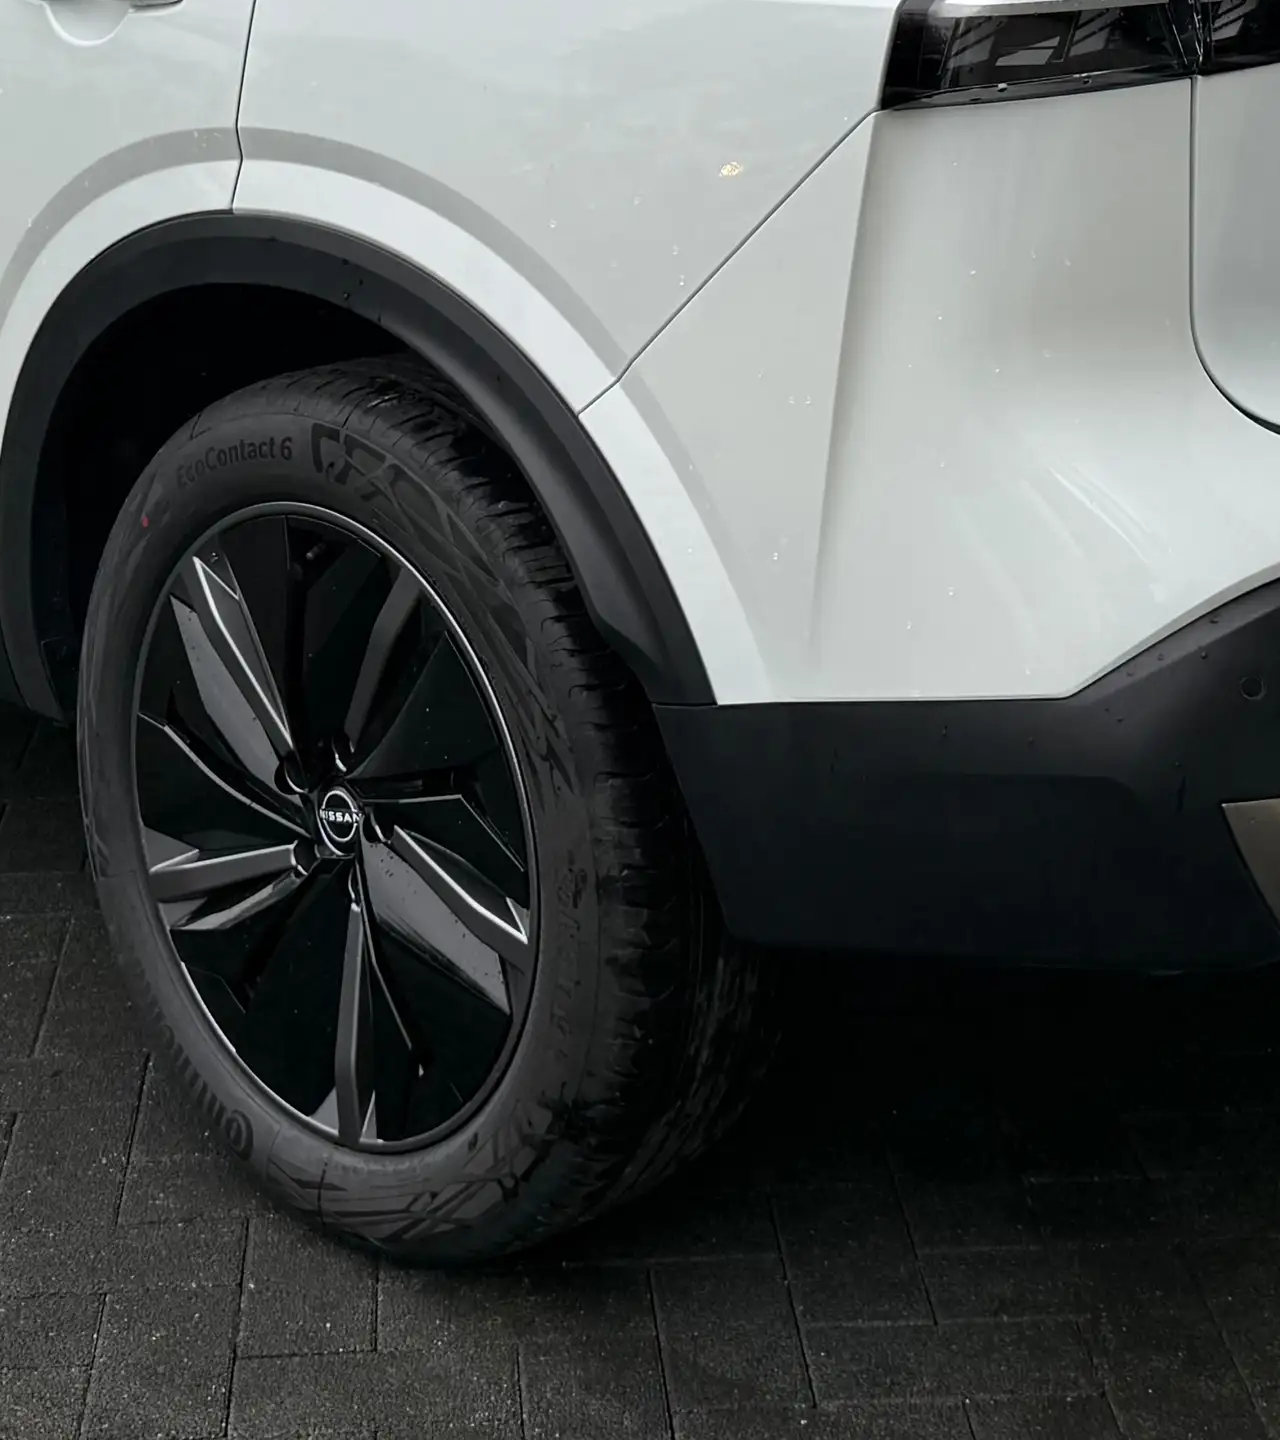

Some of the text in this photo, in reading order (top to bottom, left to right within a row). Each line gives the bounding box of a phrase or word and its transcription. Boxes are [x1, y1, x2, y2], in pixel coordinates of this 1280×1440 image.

[176, 436, 293, 489] EcoContact 6
[320, 809, 362, 823] NISSAN
